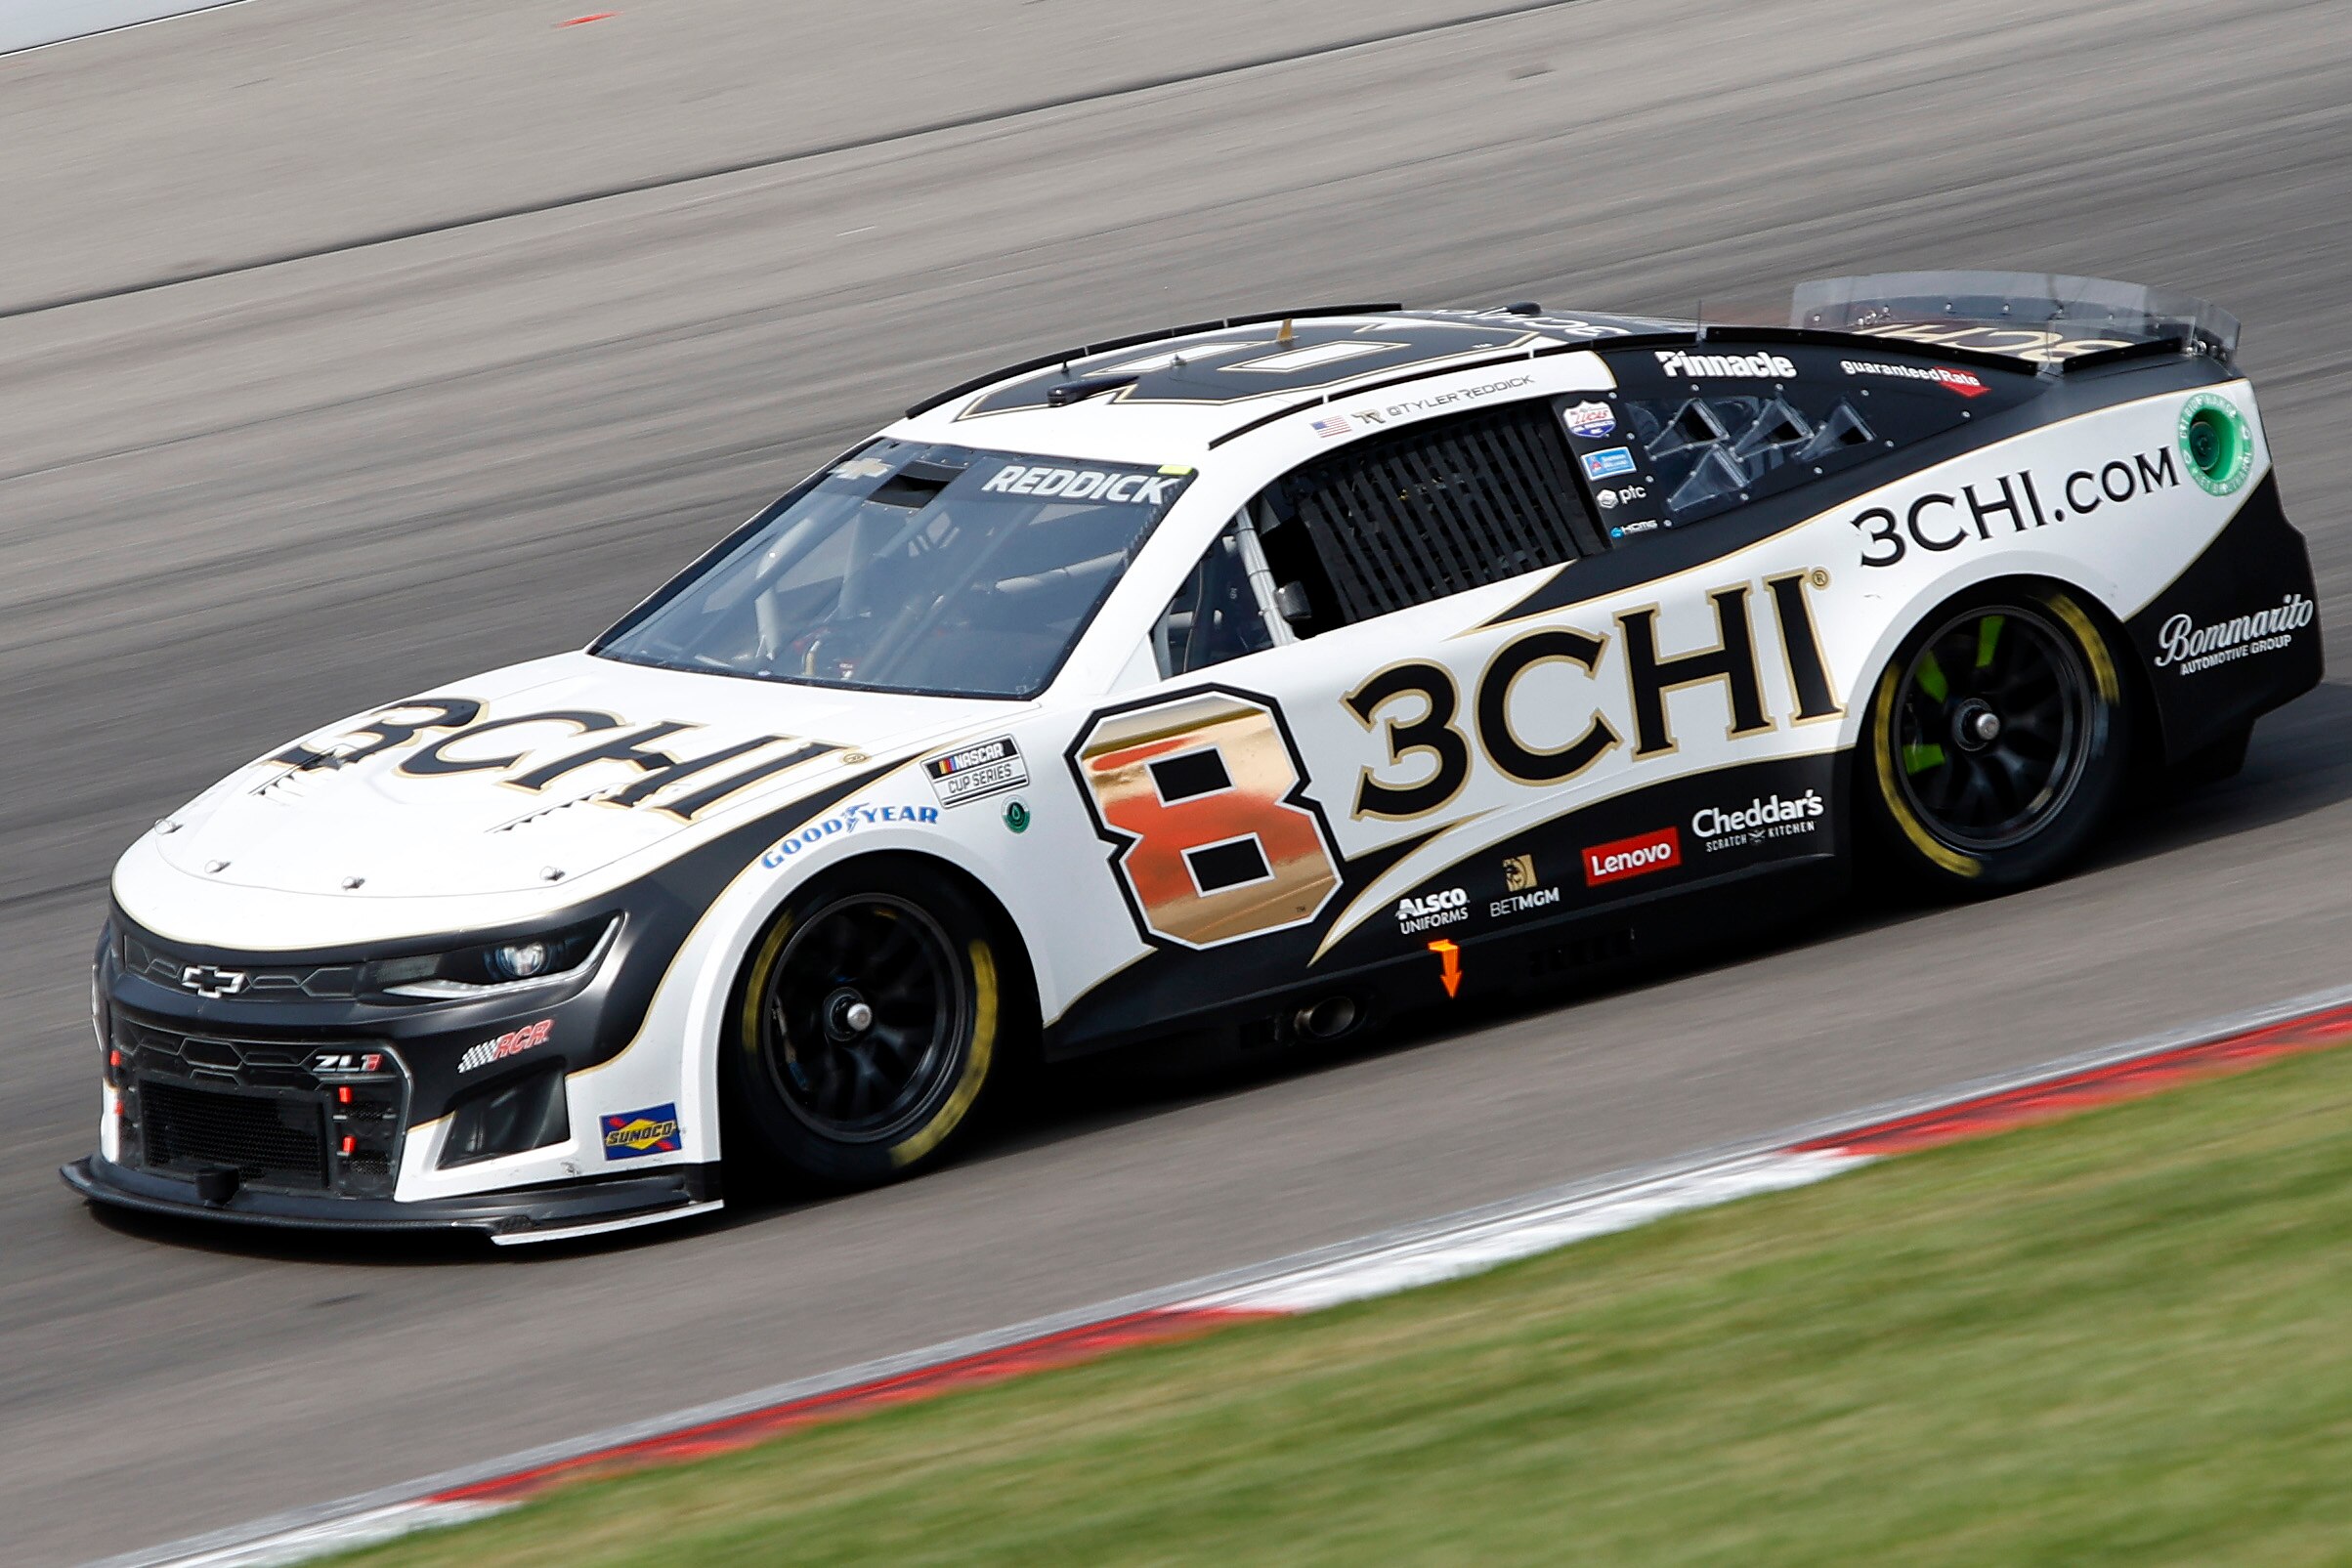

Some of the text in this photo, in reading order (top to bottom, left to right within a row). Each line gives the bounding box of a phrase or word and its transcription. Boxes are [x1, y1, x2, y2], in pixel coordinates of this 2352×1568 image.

[1653, 350, 1798, 378] Pinnacle
[981, 464, 1181, 505] REDDICK
[1618, 485, 1647, 505] ptc
[1849, 445, 2182, 568] 3CHI.COM
[2154, 593, 2314, 667] Bommarito
[2180, 634, 2292, 676] AUTOMOTIVE GROUP
[1340, 566, 1848, 823] 3CHI
[262, 696, 862, 823] 3CHI
[955, 742, 1005, 770] NASCAR
[947, 763, 1012, 794] CUP SERIES
[1063, 682, 1345, 951] 8
[1691, 788, 1825, 838] Cheddar's
[1705, 821, 1817, 853] SCRATCH KITCHEN
[1591, 842, 1672, 876] Lenovo
[1396, 887, 1469, 920] ALSCO
[1489, 887, 1561, 917] BETMGM
[1399, 907, 1469, 935] UNIFORMS
[492, 1019, 554, 1061] RCR
[312, 1053, 382, 1073] ZL1
[606, 1121, 676, 1146] SUNOCO
